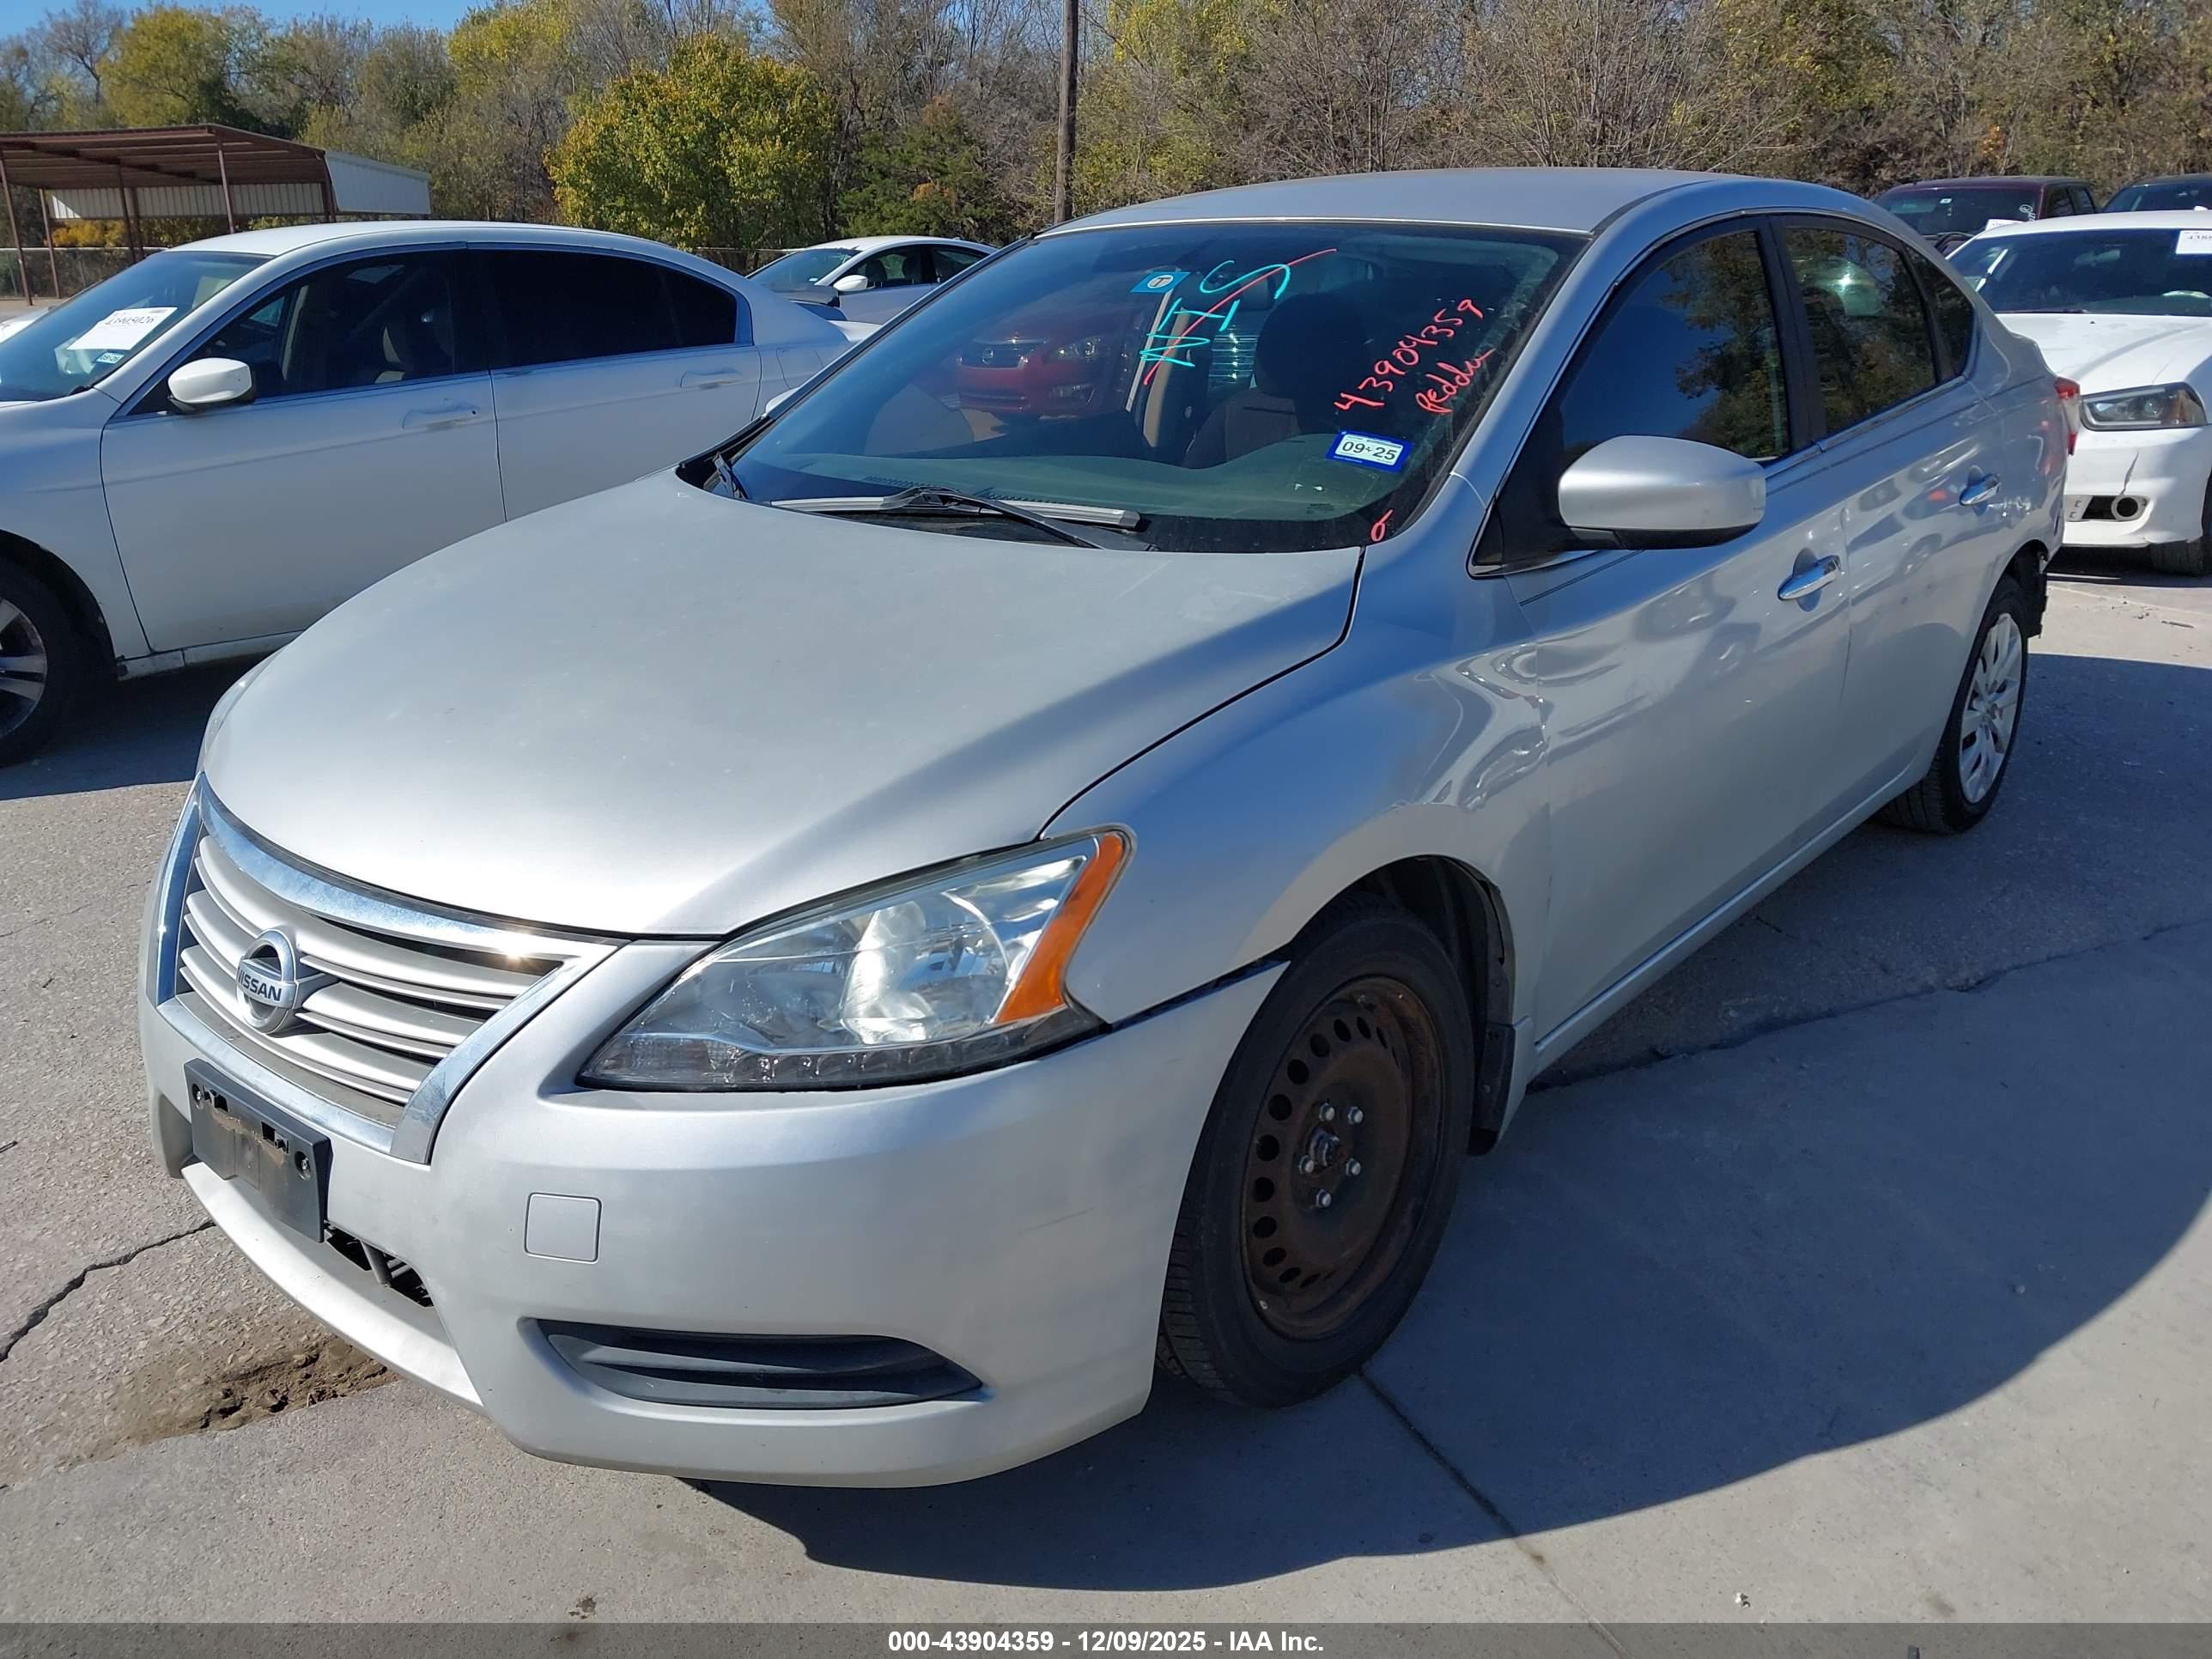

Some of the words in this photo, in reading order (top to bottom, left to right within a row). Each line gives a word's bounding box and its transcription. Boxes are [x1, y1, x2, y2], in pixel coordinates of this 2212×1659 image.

[1334, 299, 1484, 410] 43904359
[1342, 441, 1365, 453] 09
[1372, 447, 1398, 460] 25
[237, 967, 283, 1002] NISSAN
